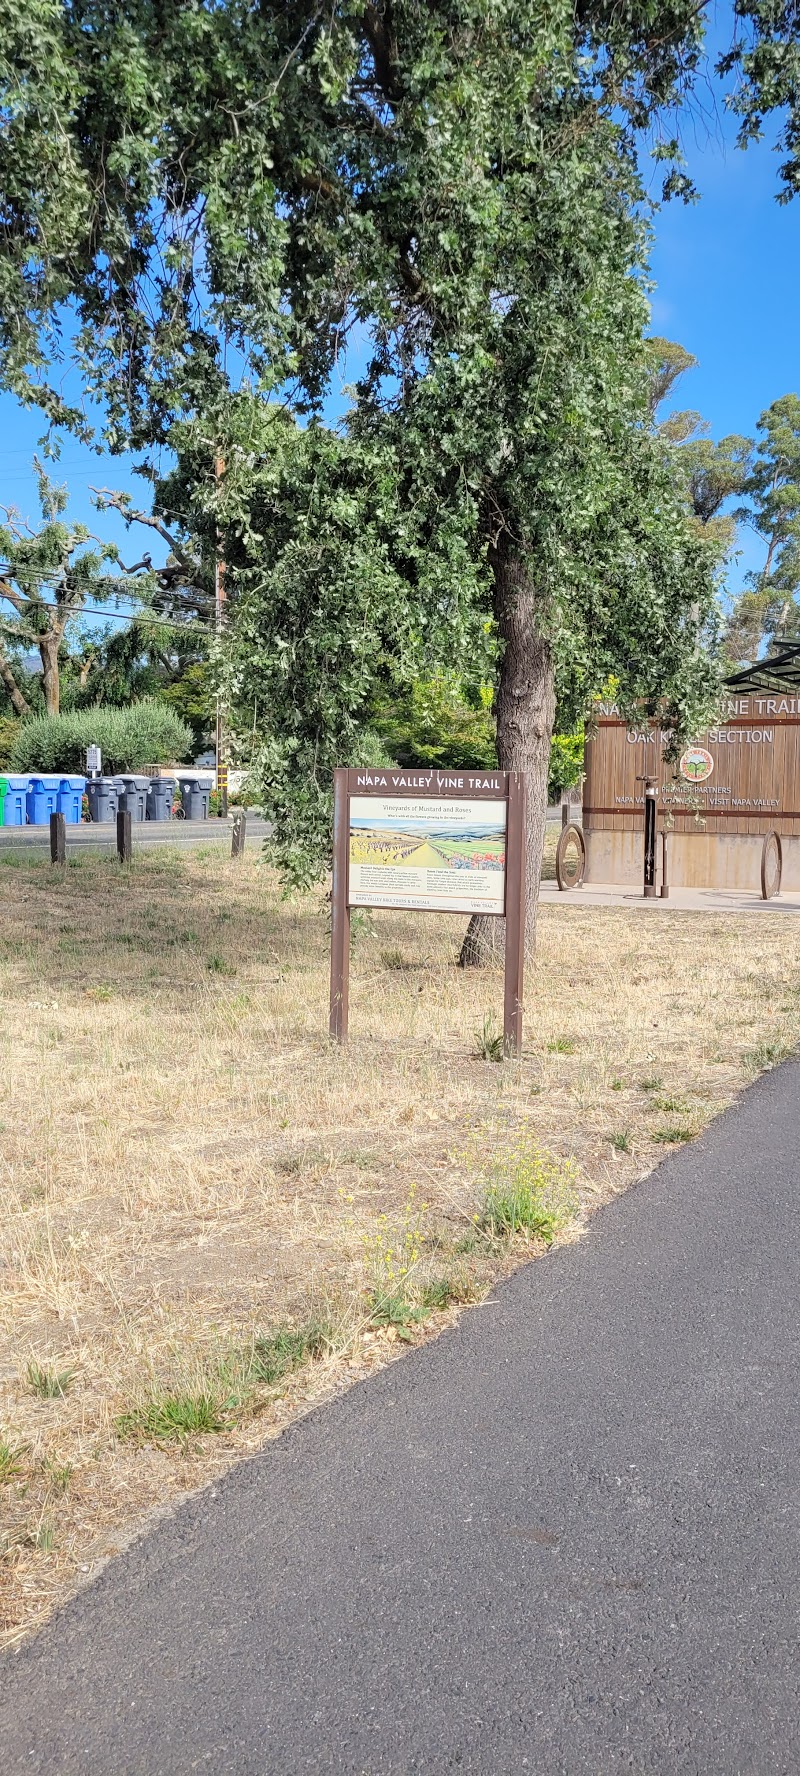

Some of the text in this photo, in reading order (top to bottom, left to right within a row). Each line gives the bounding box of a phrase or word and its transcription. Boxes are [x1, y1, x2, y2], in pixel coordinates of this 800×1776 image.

[719, 700, 748, 714] INE
[755, 700, 800, 714] TRAI
[627, 731, 655, 743] OAK
[709, 730, 773, 743] SECTION
[357, 775, 500, 789] NAPA VALLEY VINE TRAIL
